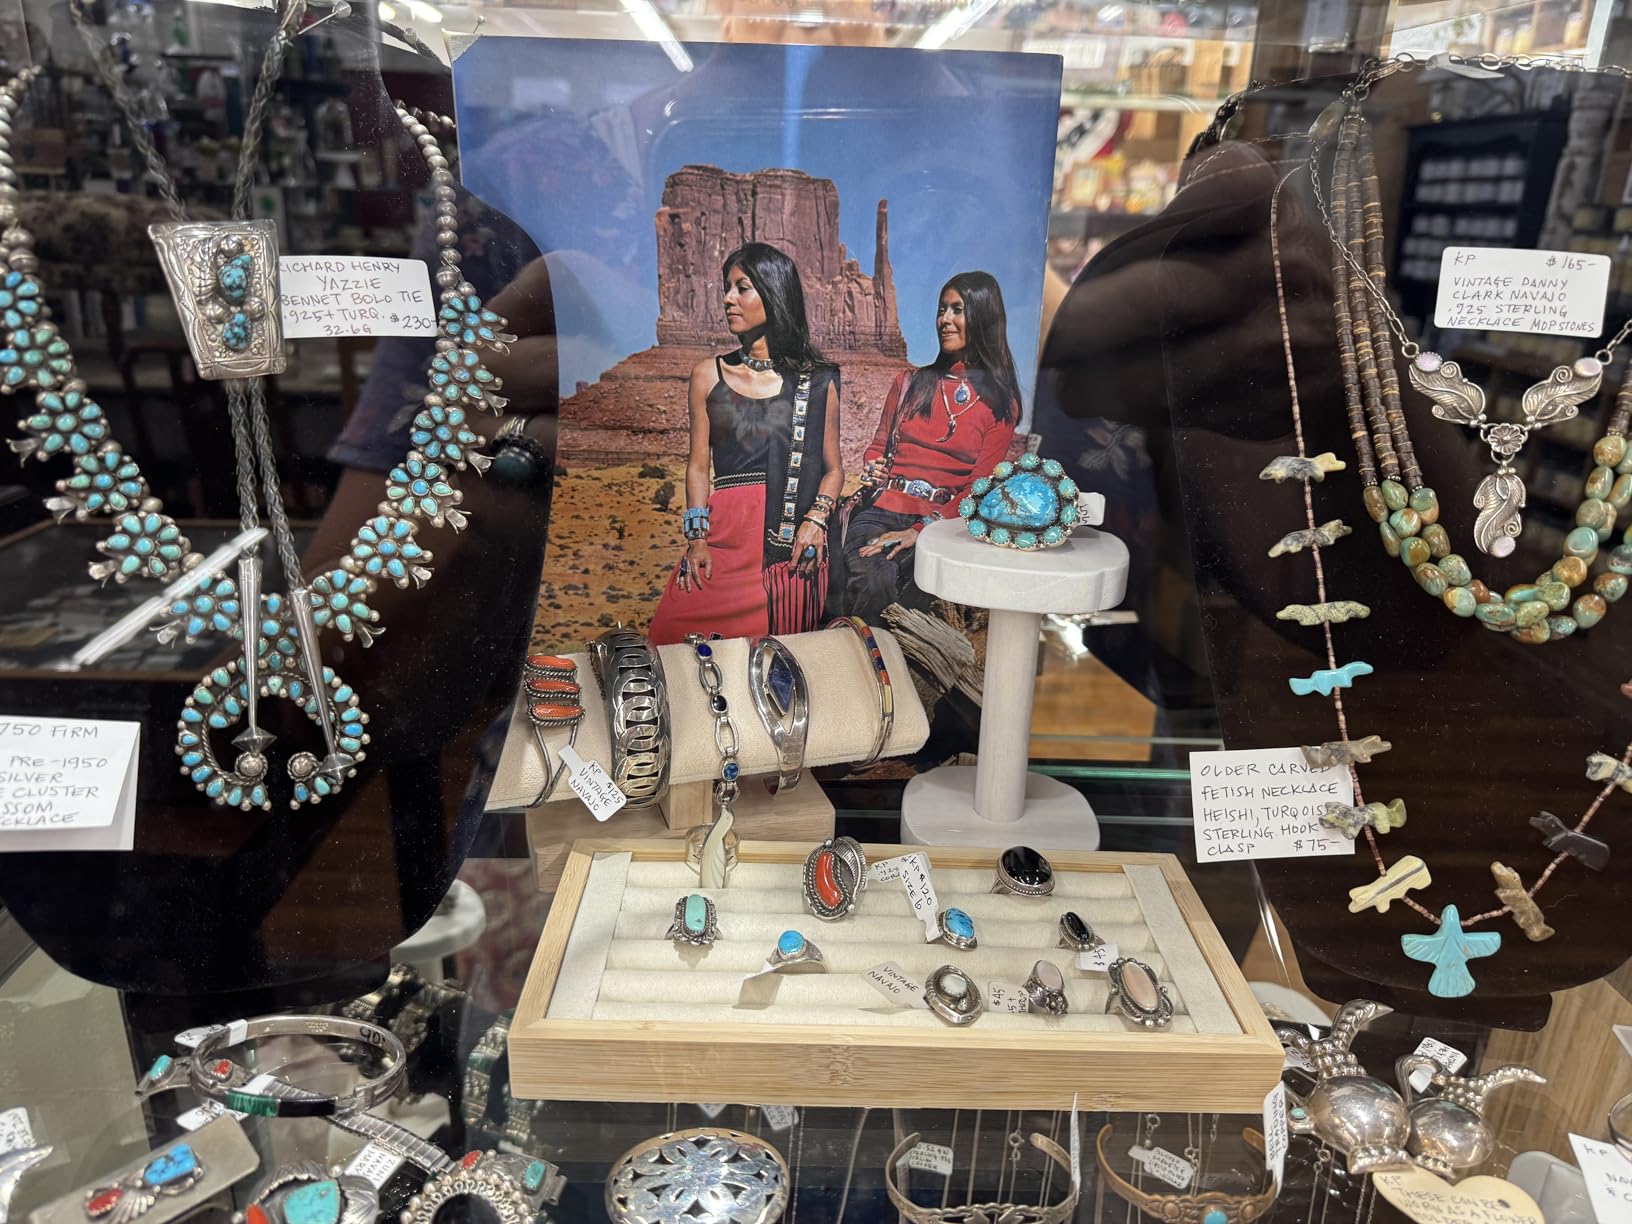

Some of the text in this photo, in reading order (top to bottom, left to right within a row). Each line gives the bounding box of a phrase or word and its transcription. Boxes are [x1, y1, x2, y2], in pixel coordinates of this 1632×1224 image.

[351, 261, 400, 273] HENRY
[316, 275, 382, 292] YAZZIE
[1453, 276, 1568, 290] VINTAGE DANNY
[280, 290, 424, 307] BENNET BOLO TIE
[1453, 289, 1567, 302] CLARK NAVAJO
[1494, 304, 1568, 318] STERLING
[1447, 316, 1524, 328] NECKLACE
[52, 725, 98, 738] FIRM
[0, 771, 63, 784] SILVER
[1200, 763, 1261, 777] OLDER
[12, 785, 99, 799] CLUSTER
[571, 779, 599, 811] NAVAJO
[580, 768, 612, 807] VINTAGE
[1201, 782, 1339, 801] FETISH NECKLACE
[0, 811, 80, 826] CKLACE
[1260, 805, 1328, 821] TURQOIS
[1203, 822, 1319, 841] STERLING HOOK
[1207, 843, 1256, 857] CLASP
[902, 870, 916, 898] SIZE
[867, 971, 900, 993] NAVAJO
[883, 966, 919, 991] VINTAGE
